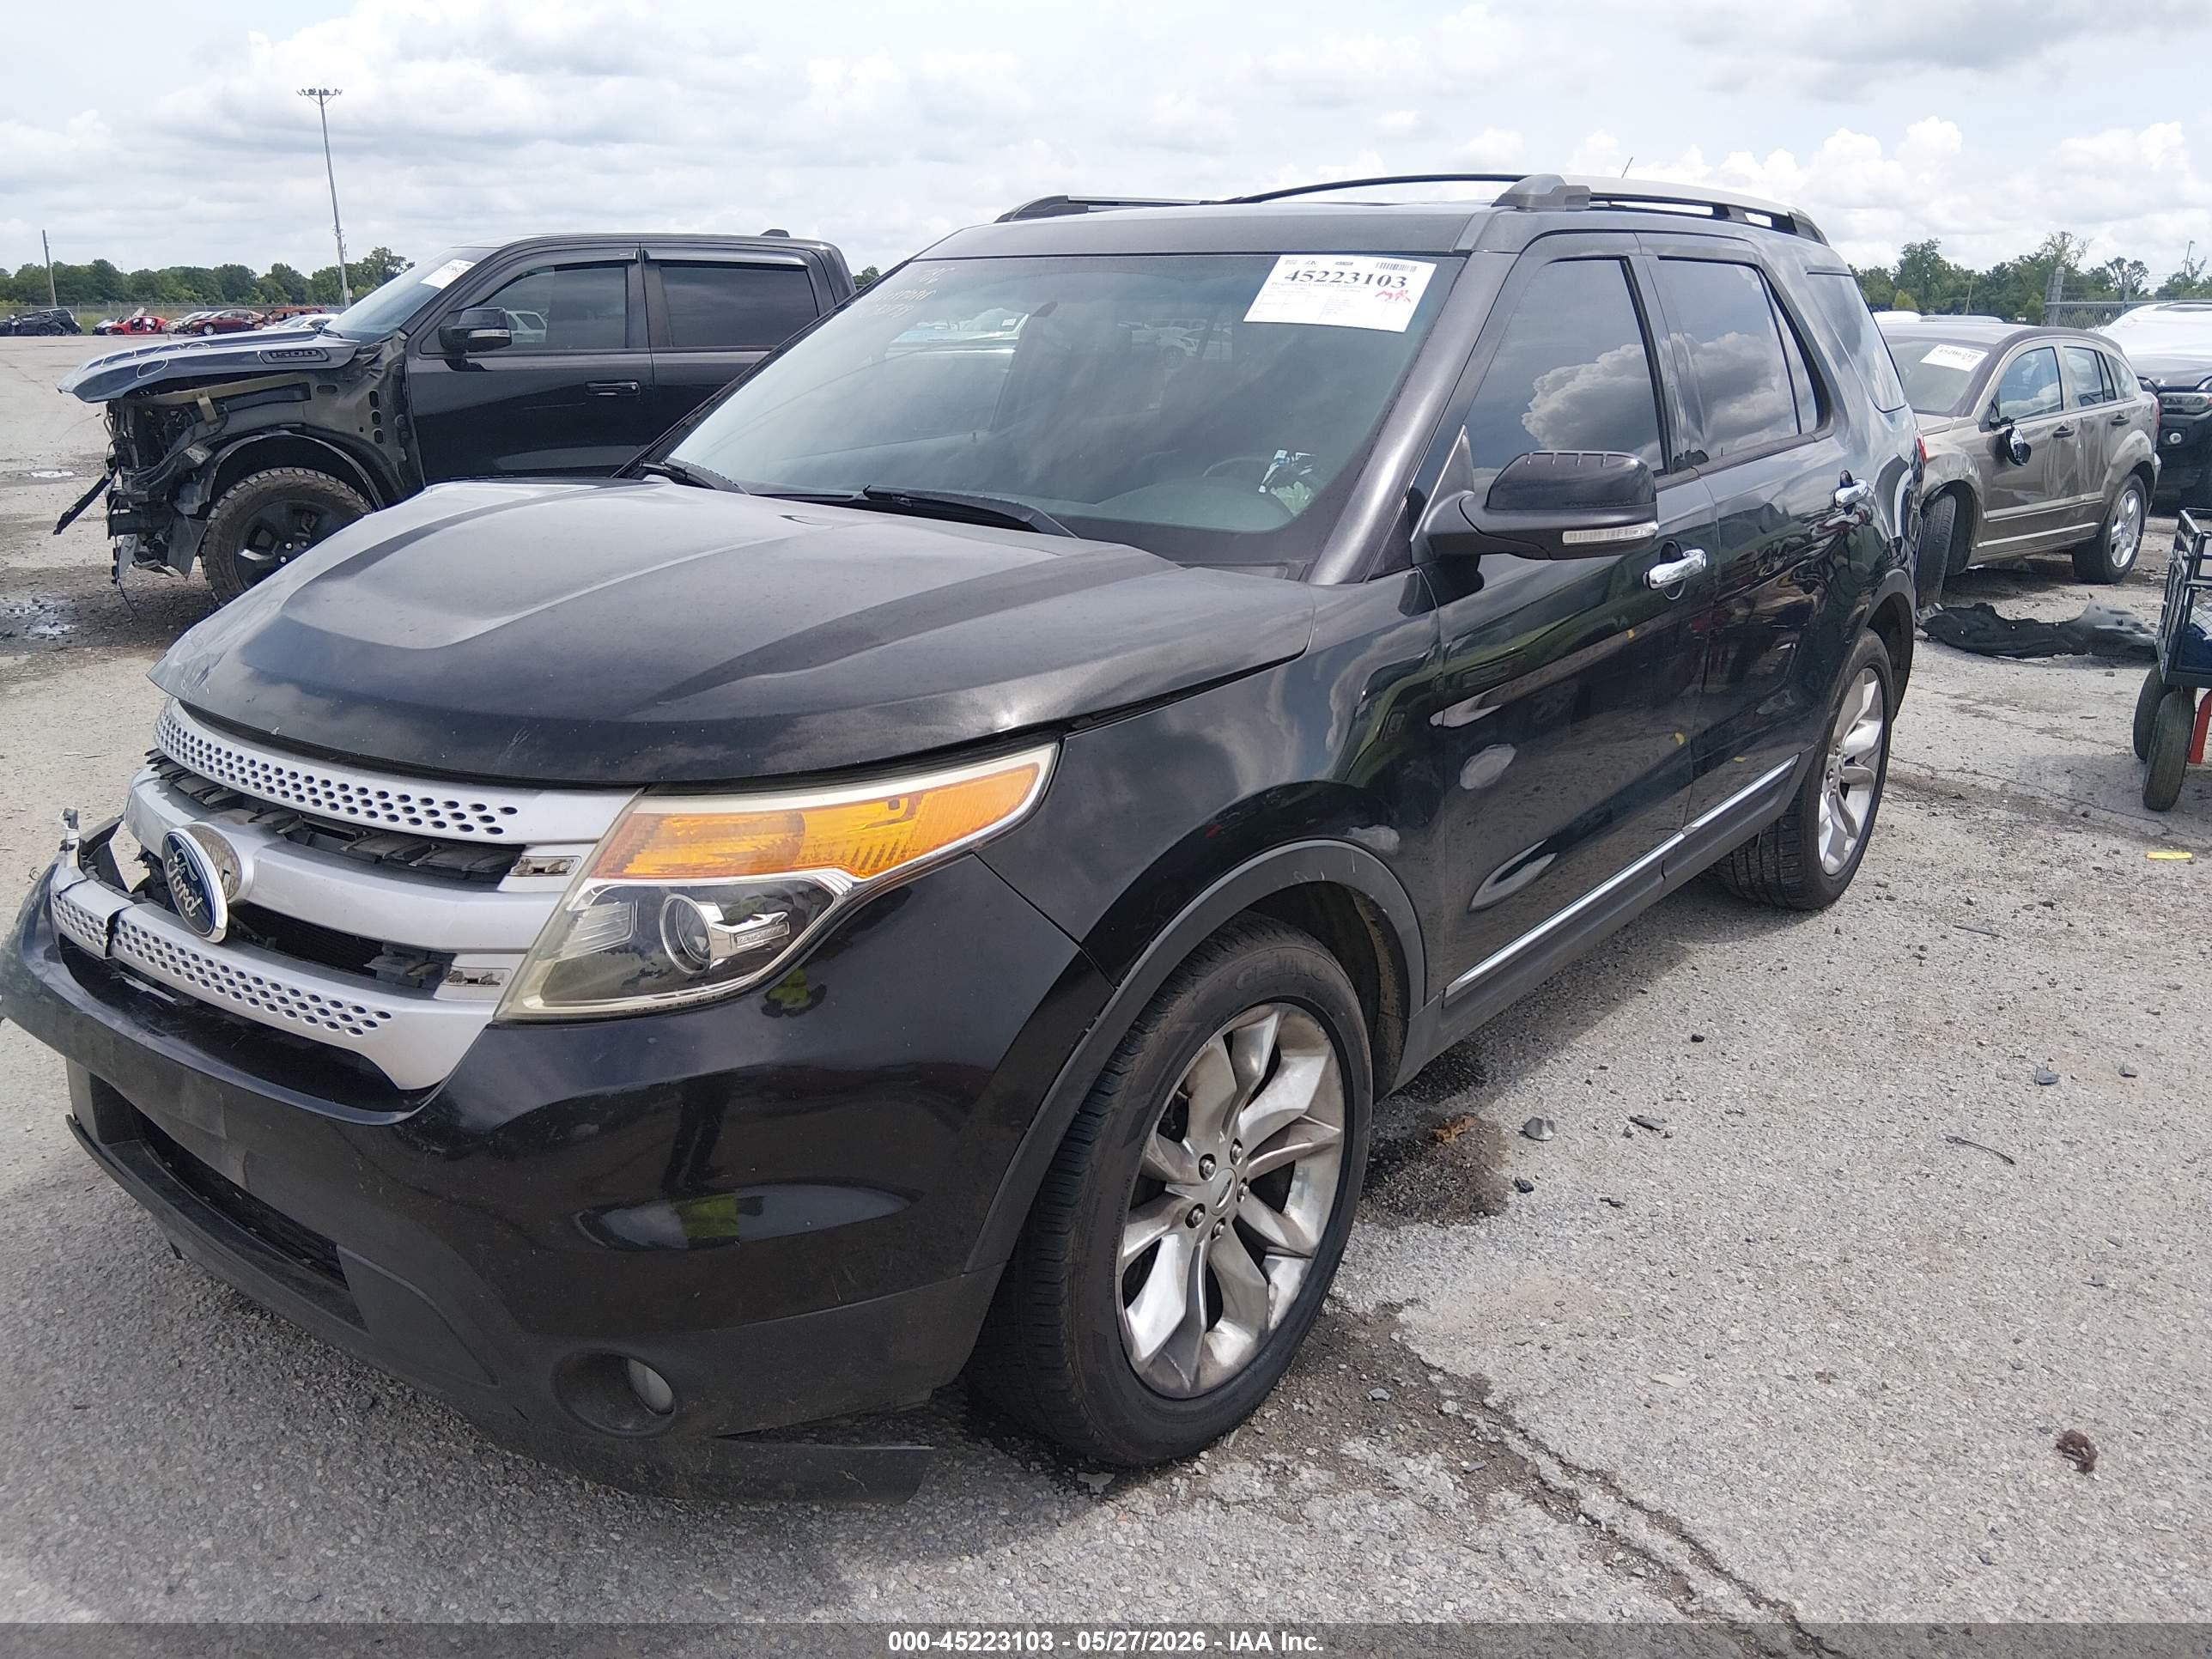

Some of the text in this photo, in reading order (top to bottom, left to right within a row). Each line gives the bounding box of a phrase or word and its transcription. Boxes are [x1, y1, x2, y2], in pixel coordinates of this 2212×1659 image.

[1285, 269, 1407, 289] 45223103
[268, 349, 317, 358] 1500
[167, 848, 203, 917] Ford
